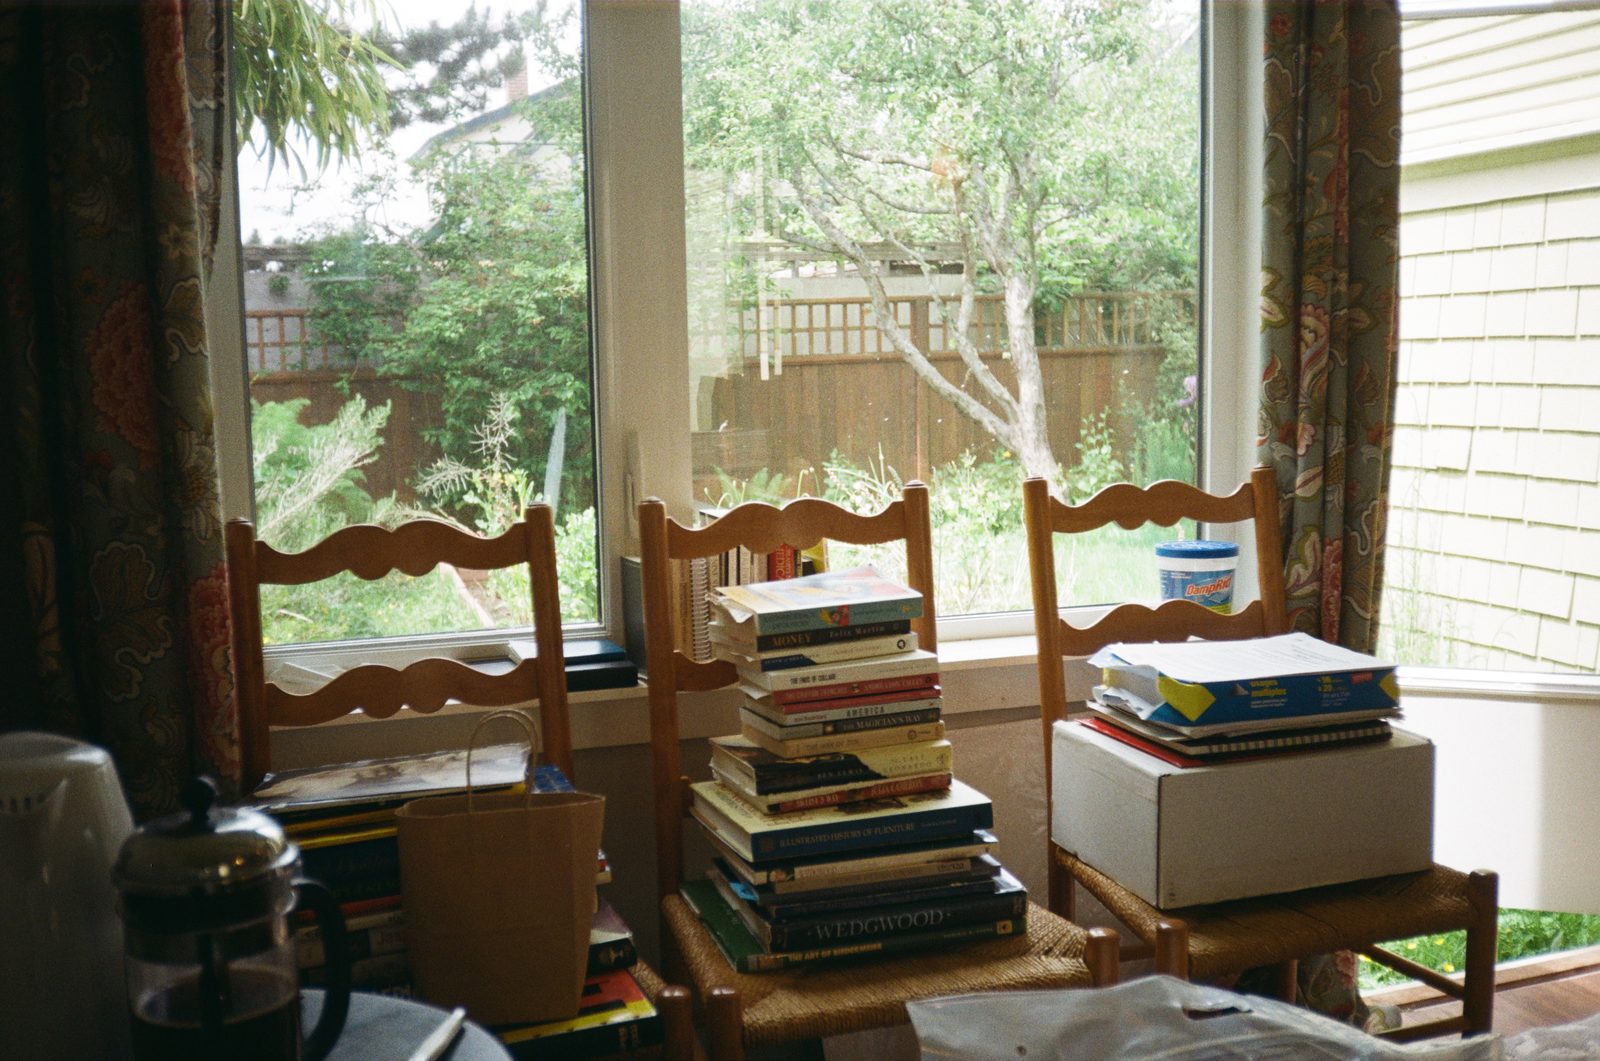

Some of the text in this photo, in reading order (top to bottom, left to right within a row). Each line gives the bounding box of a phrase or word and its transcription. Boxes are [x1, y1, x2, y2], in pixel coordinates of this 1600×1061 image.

[772, 626, 886, 647] MONEY Felix Martin
[846, 706, 885, 717] AMERICA
[856, 717, 903, 728] MAGICIAN'S
[904, 714, 921, 724] WAY
[779, 833, 829, 848] ILLUSTRATED
[831, 829, 862, 842] HISTORY
[863, 827, 873, 838] OF
[874, 822, 915, 837] FURNITURE
[815, 909, 944, 940] WEDGWOOD
[788, 951, 804, 961] THE
[805, 949, 819, 960] ART
[820, 948, 832, 958] OF
